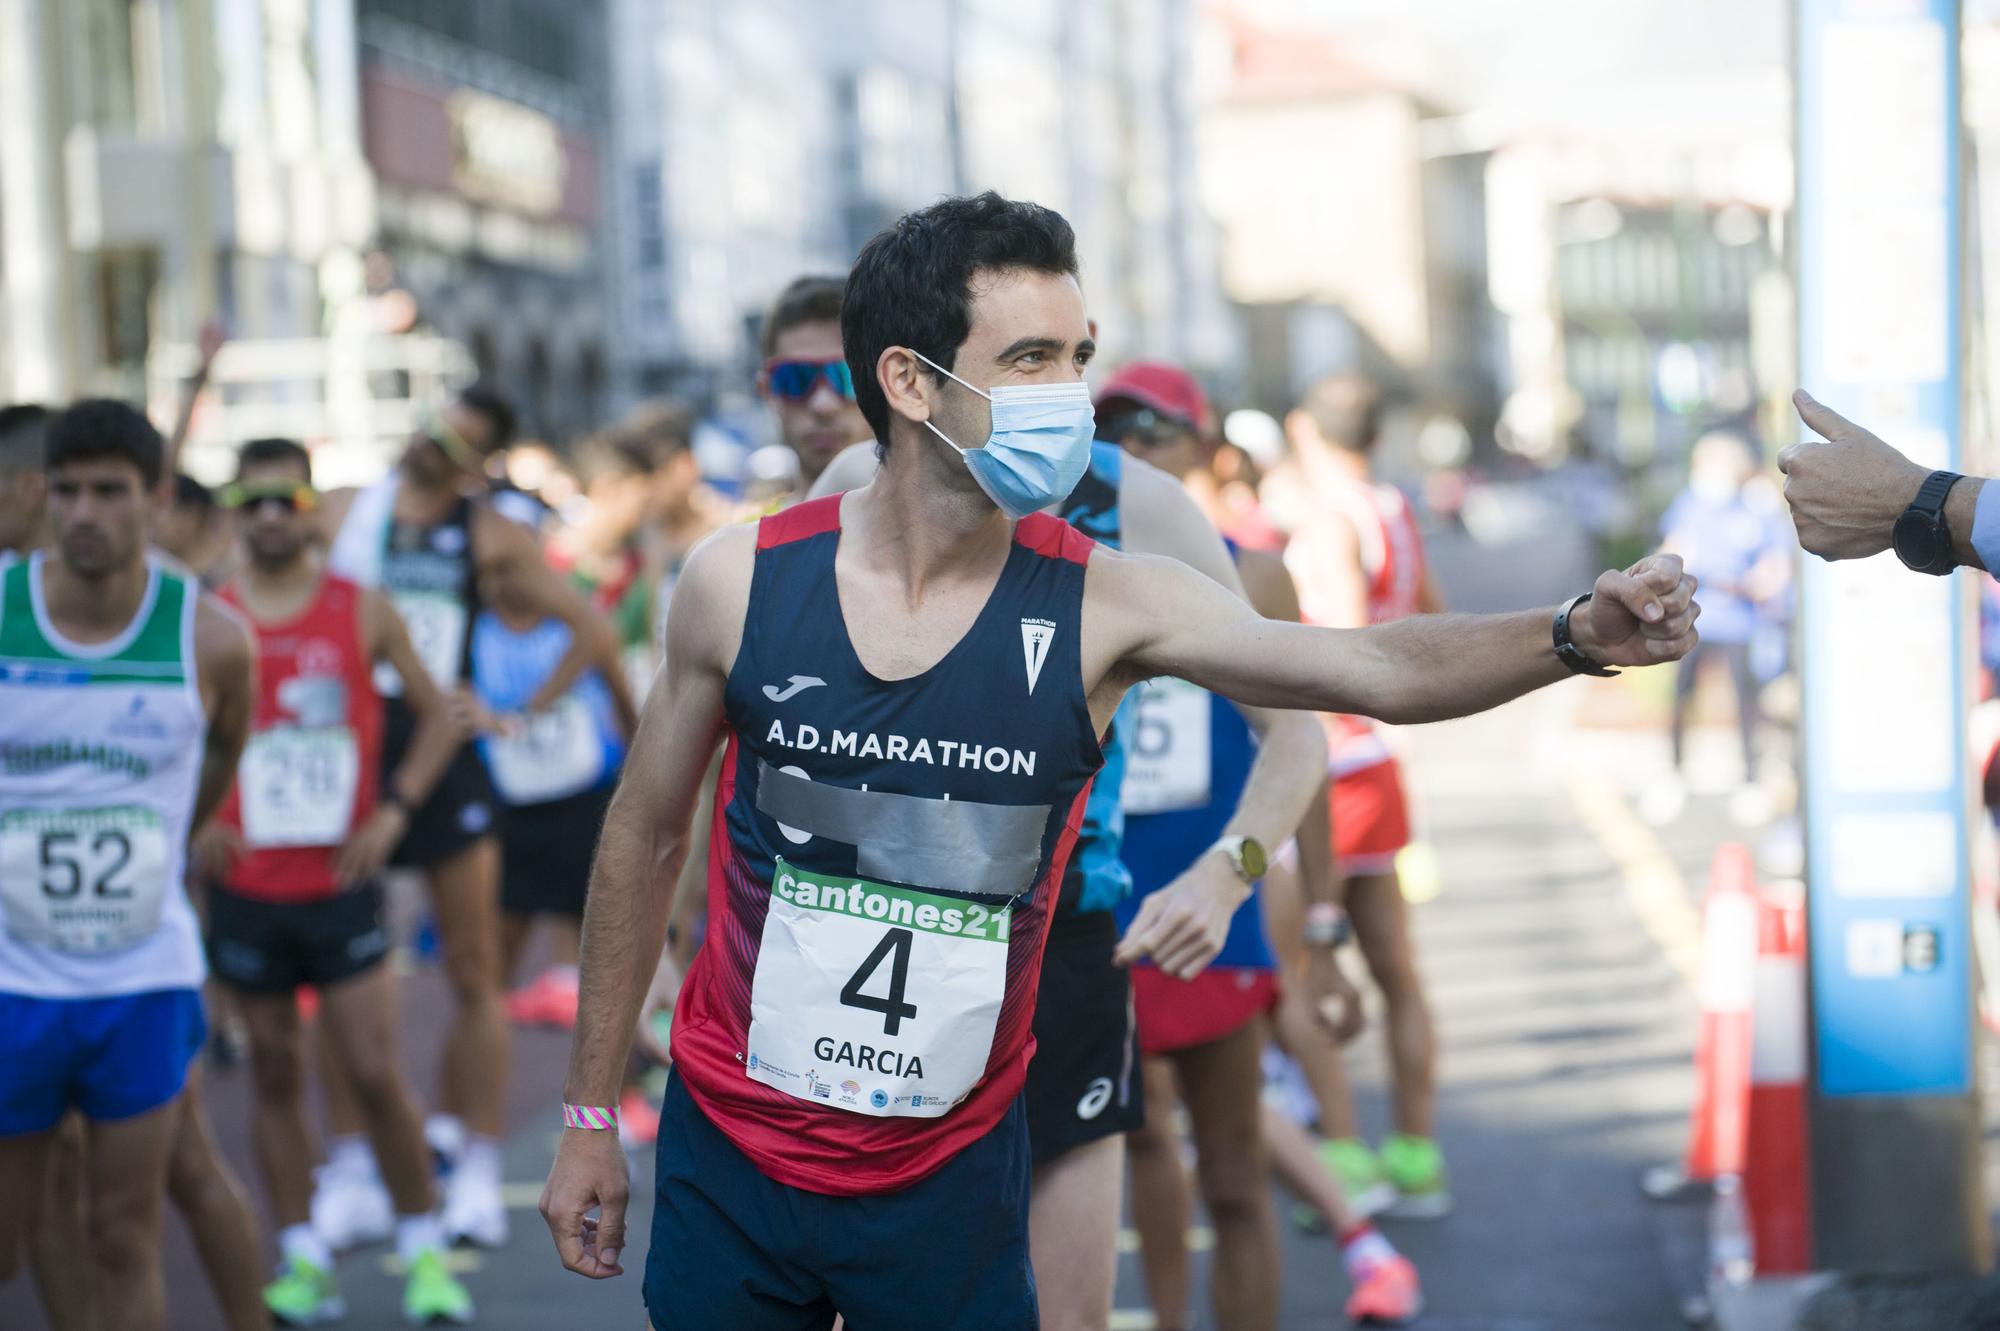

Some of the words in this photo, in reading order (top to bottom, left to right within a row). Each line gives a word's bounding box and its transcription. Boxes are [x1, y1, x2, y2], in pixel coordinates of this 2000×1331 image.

[1021, 617, 1057, 628] MARATHON
[766, 719, 1037, 777] A.D.MARATHON
[39, 831, 134, 900] 52
[778, 873, 1012, 941] cantones21
[840, 927, 917, 1037] 4
[814, 1036, 924, 1080] GARCIA
